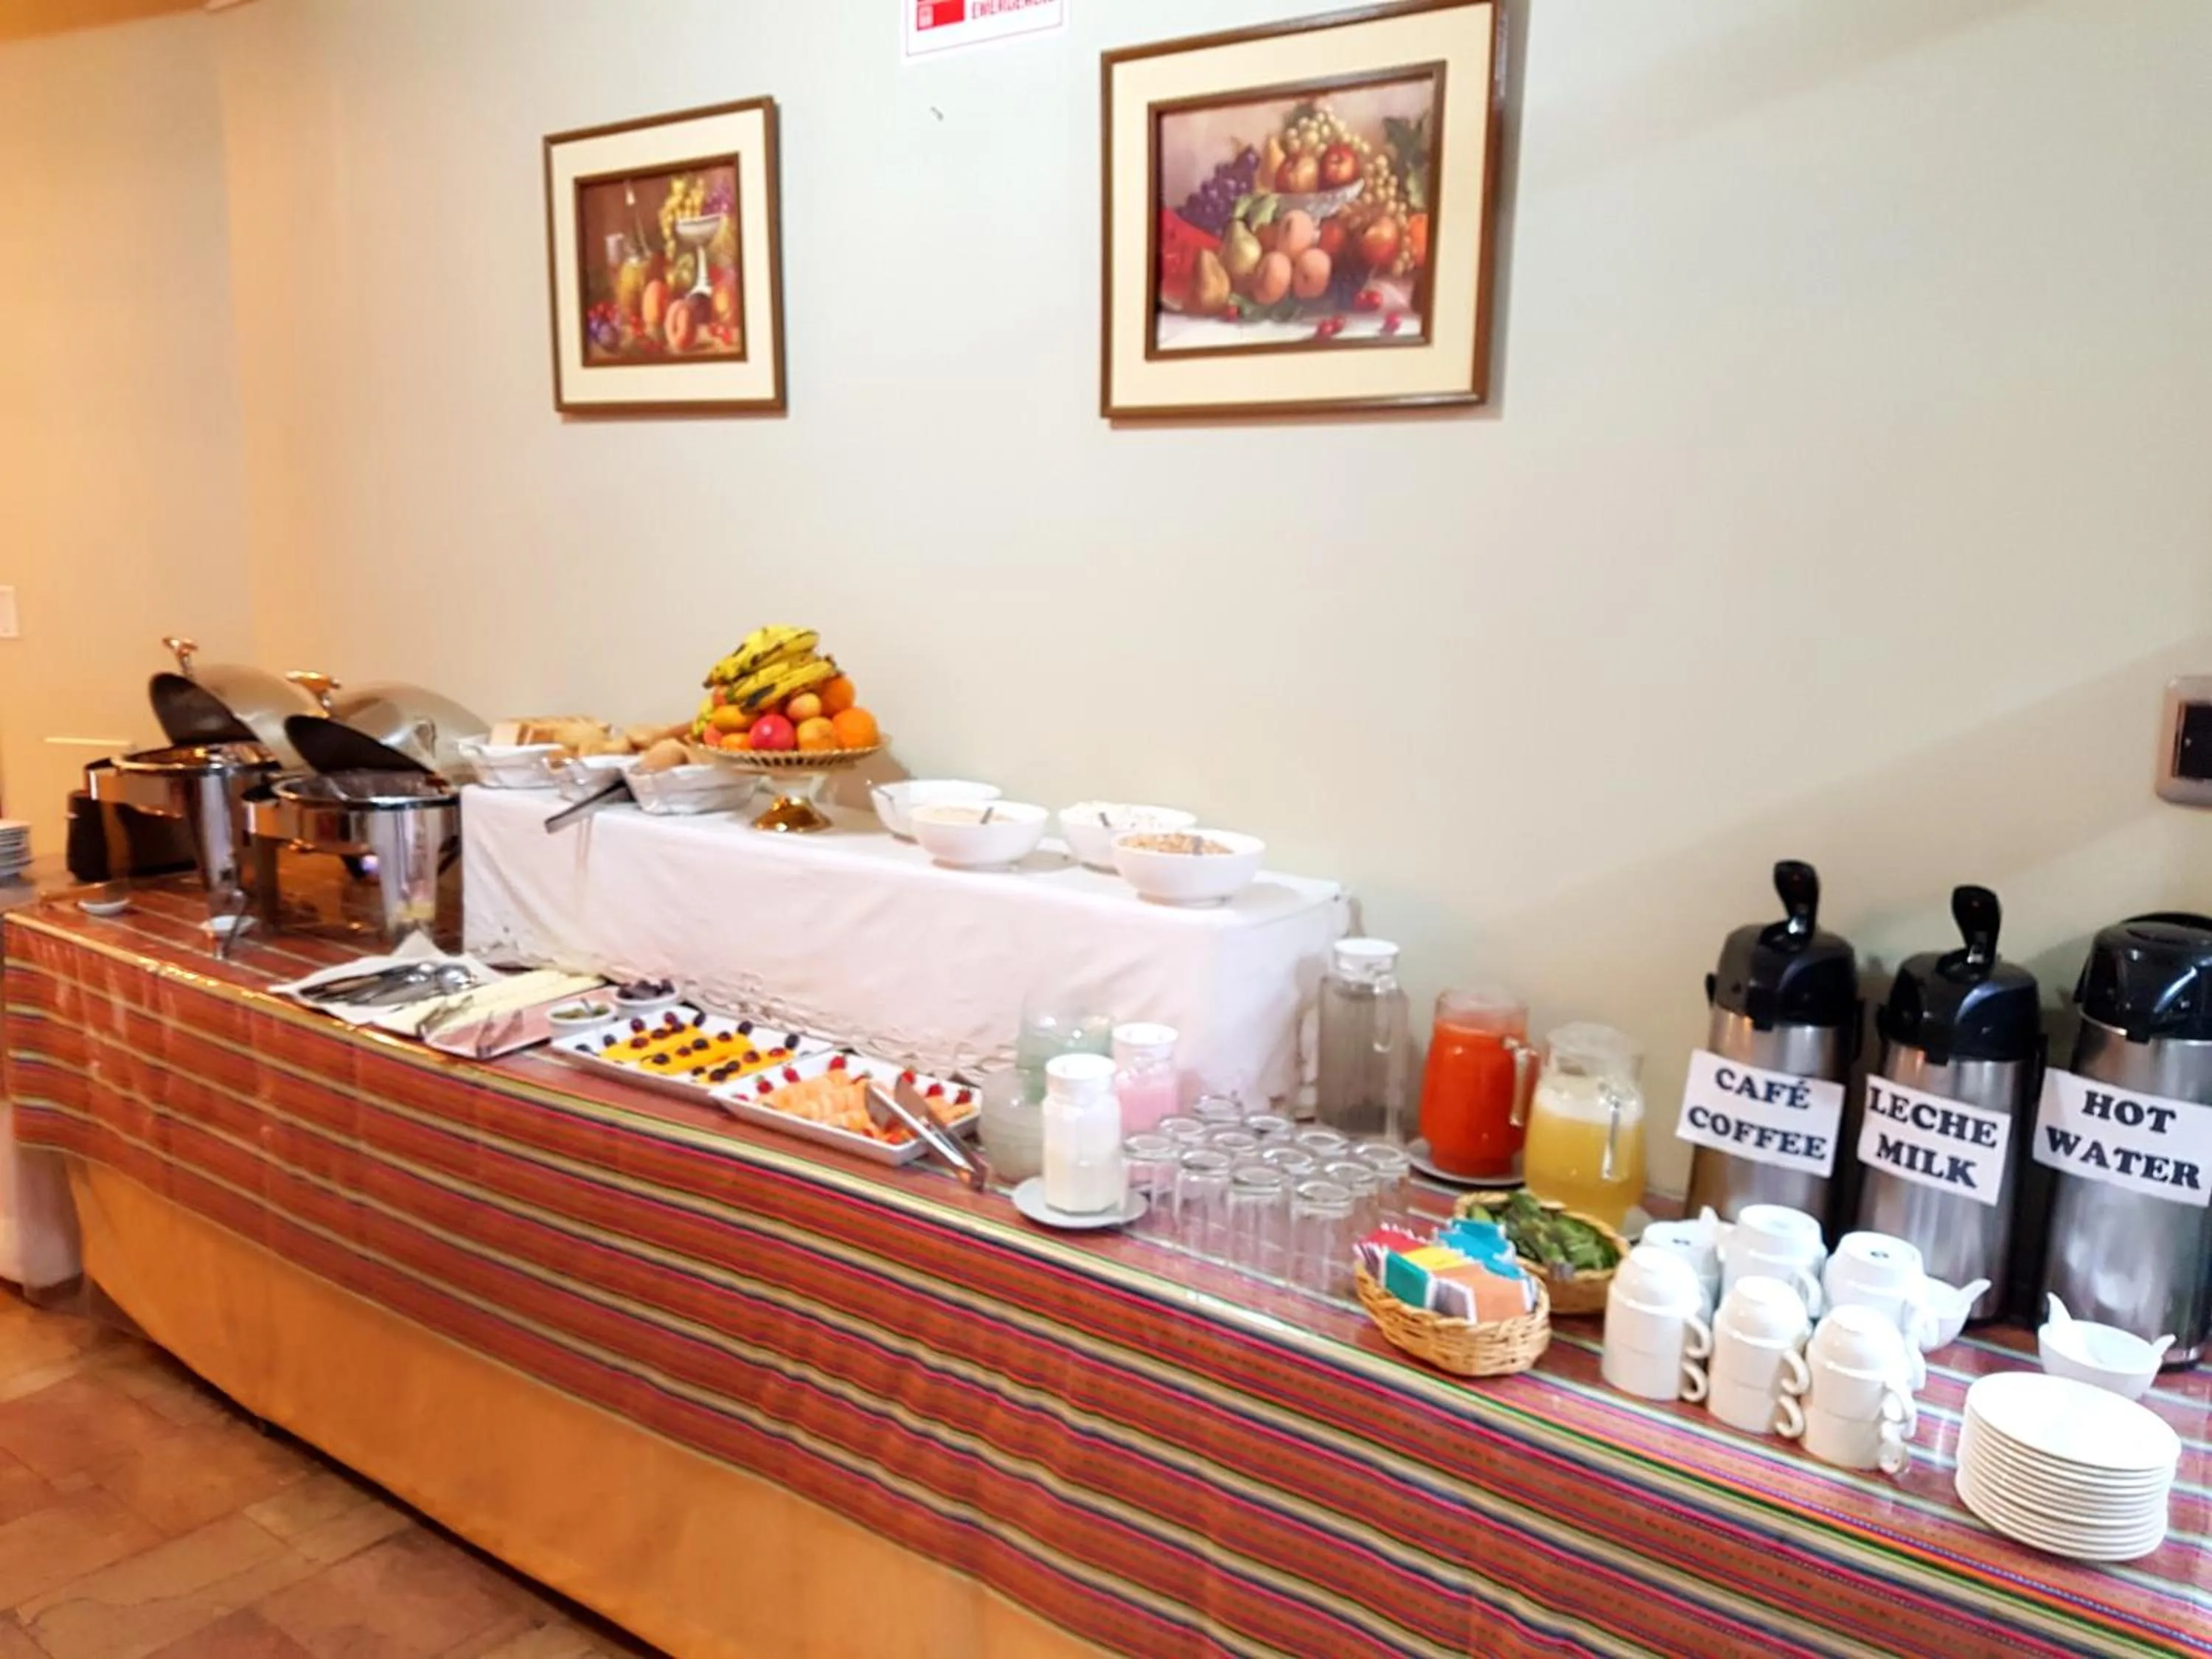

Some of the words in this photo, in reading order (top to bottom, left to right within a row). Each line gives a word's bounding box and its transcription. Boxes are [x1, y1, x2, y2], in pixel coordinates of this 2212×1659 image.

[1715, 1068, 1810, 1110] CAFÉ
[2081, 1090, 2177, 1134] HOT
[1688, 1107, 1827, 1161] COFFEE
[1869, 1087, 1997, 1148] LECHE
[1877, 1133, 1978, 1189] MILK
[2045, 1125, 2200, 1190] WATER
